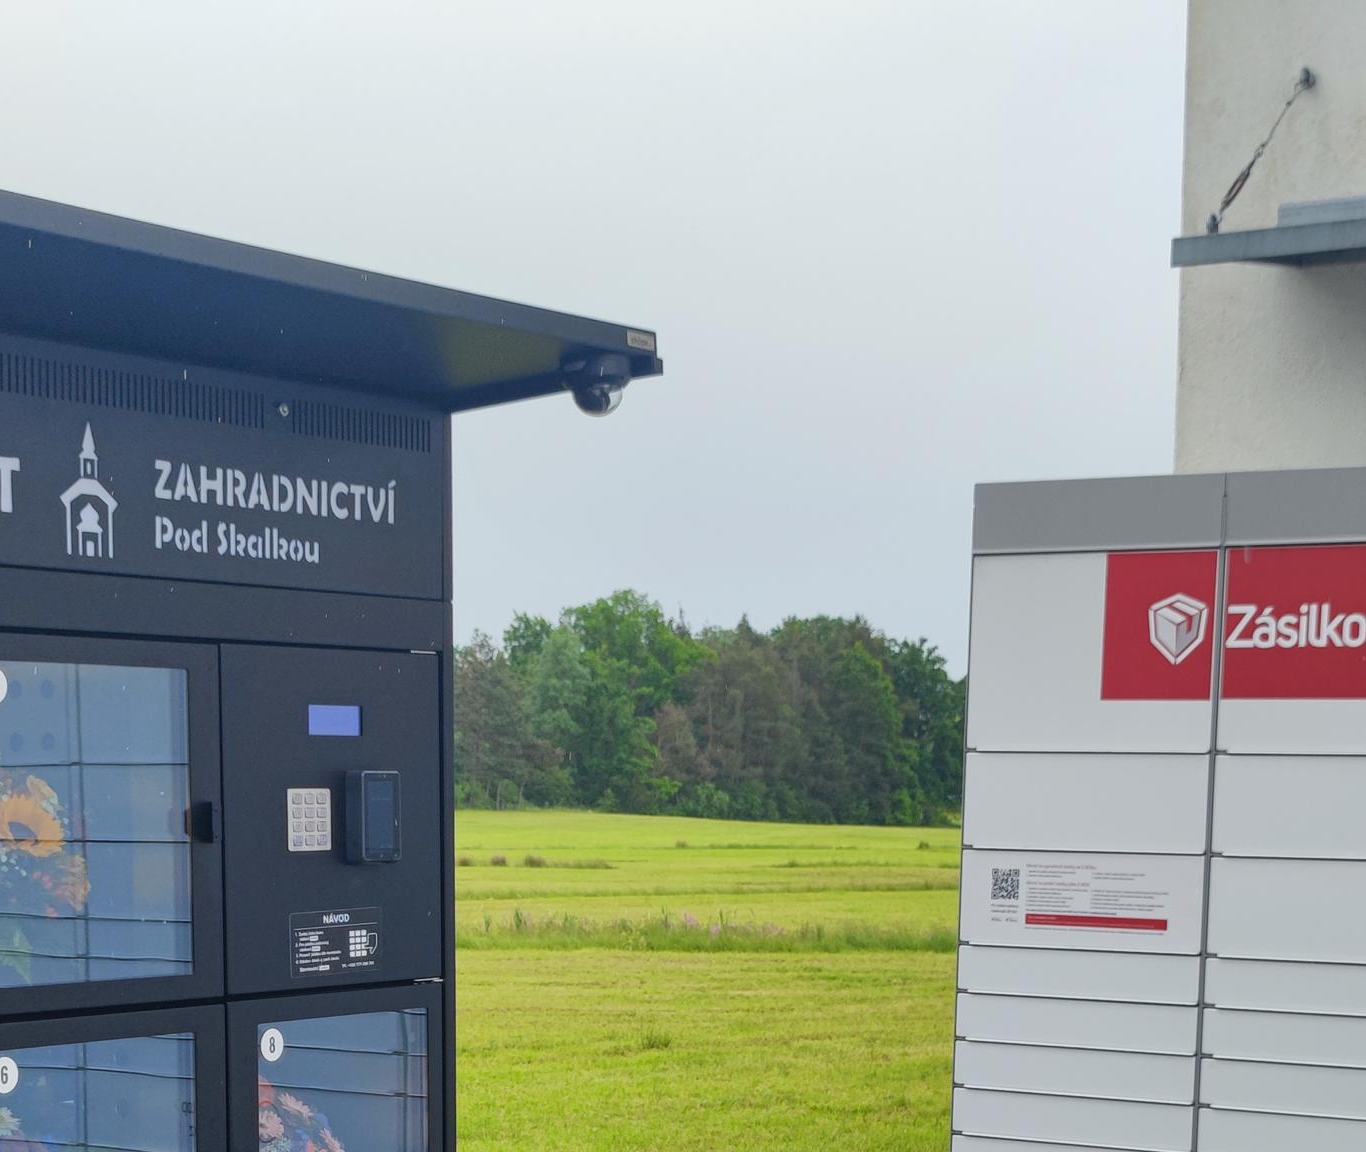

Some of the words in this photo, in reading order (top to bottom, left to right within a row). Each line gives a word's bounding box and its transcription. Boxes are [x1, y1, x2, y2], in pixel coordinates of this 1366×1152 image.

[153, 458, 397, 525] ZAHRADNICTVÍ
[154, 515, 209, 553] Pod
[216, 520, 321, 565] Skalkou
[322, 913, 350, 924] NÁVOD
[268, 1036, 276, 1055] 8
[0, 1065, 9, 1085] 6
